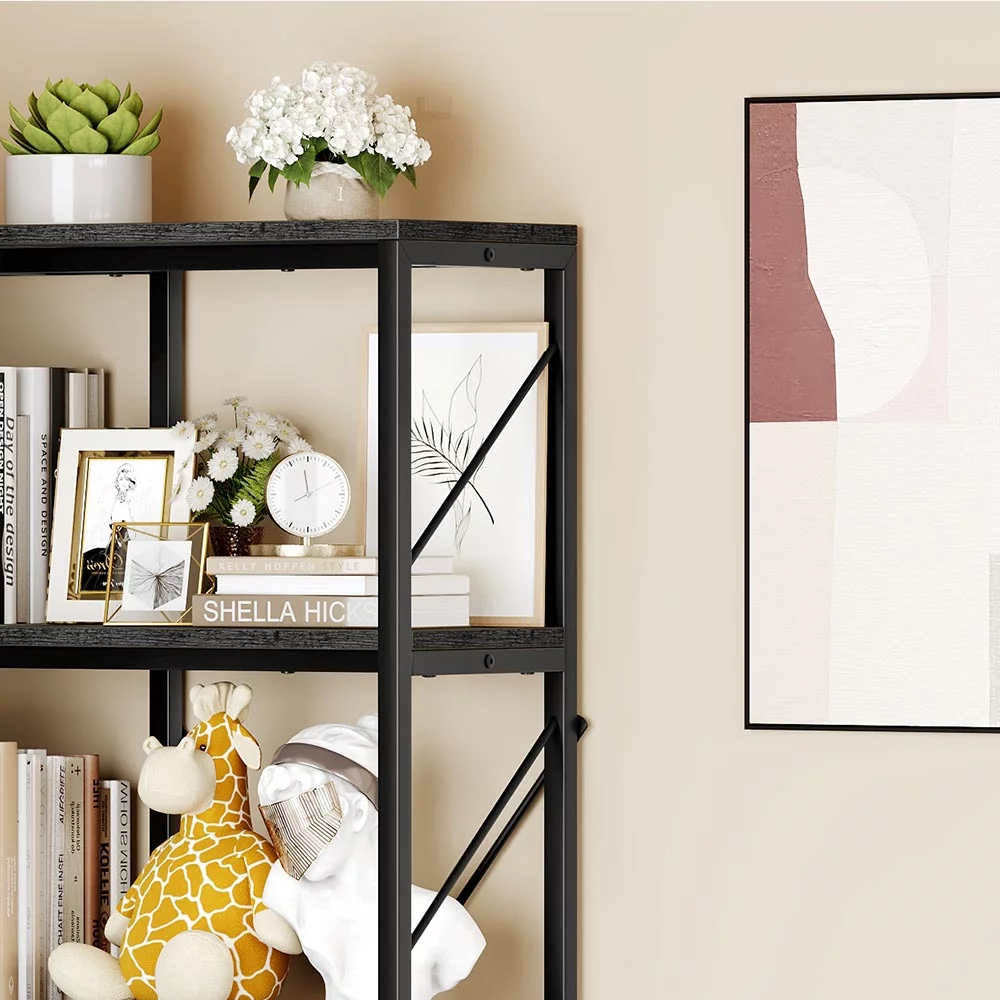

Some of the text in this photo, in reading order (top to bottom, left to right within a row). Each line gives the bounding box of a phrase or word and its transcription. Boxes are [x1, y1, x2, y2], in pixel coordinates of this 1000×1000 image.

[4, 417, 14, 587] Day of the design
[218, 561, 256, 571] KELLY
[321, 561, 360, 571] STYLE
[203, 600, 296, 623] SHELLA
